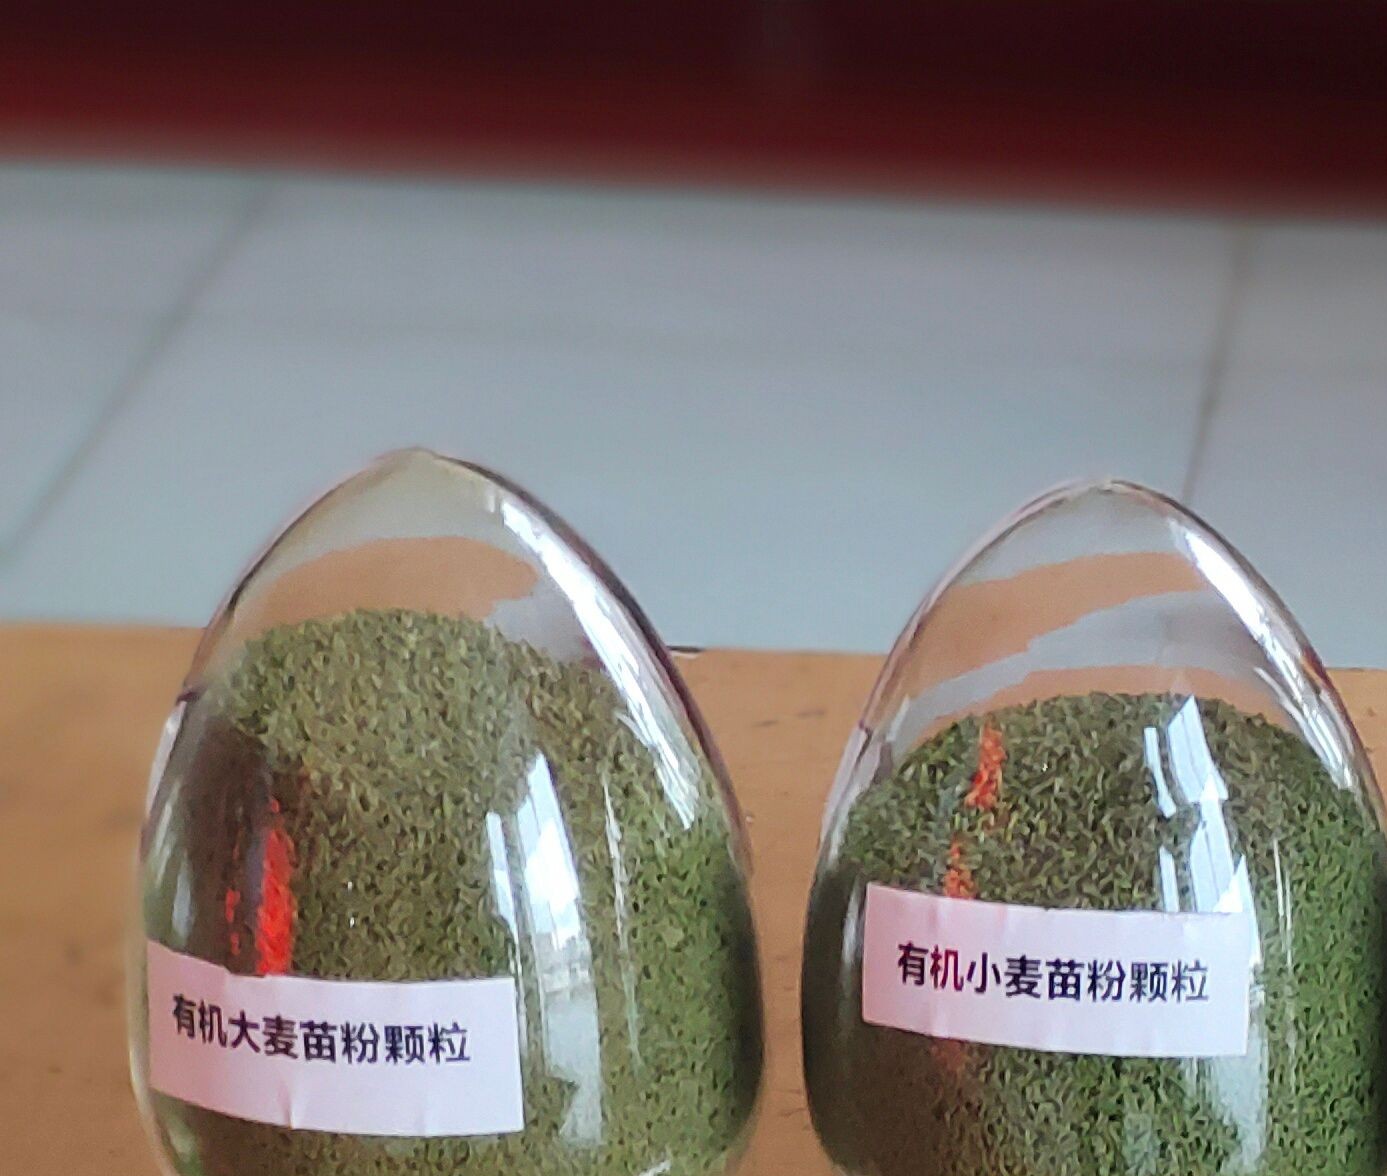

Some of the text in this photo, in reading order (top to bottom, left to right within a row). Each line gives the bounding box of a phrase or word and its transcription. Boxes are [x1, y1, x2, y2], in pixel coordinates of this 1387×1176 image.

[896, 940, 1210, 1004] 有机小麦苗粉颗粒
[171, 993, 472, 1065] 有机大麦苗粉颗粒
